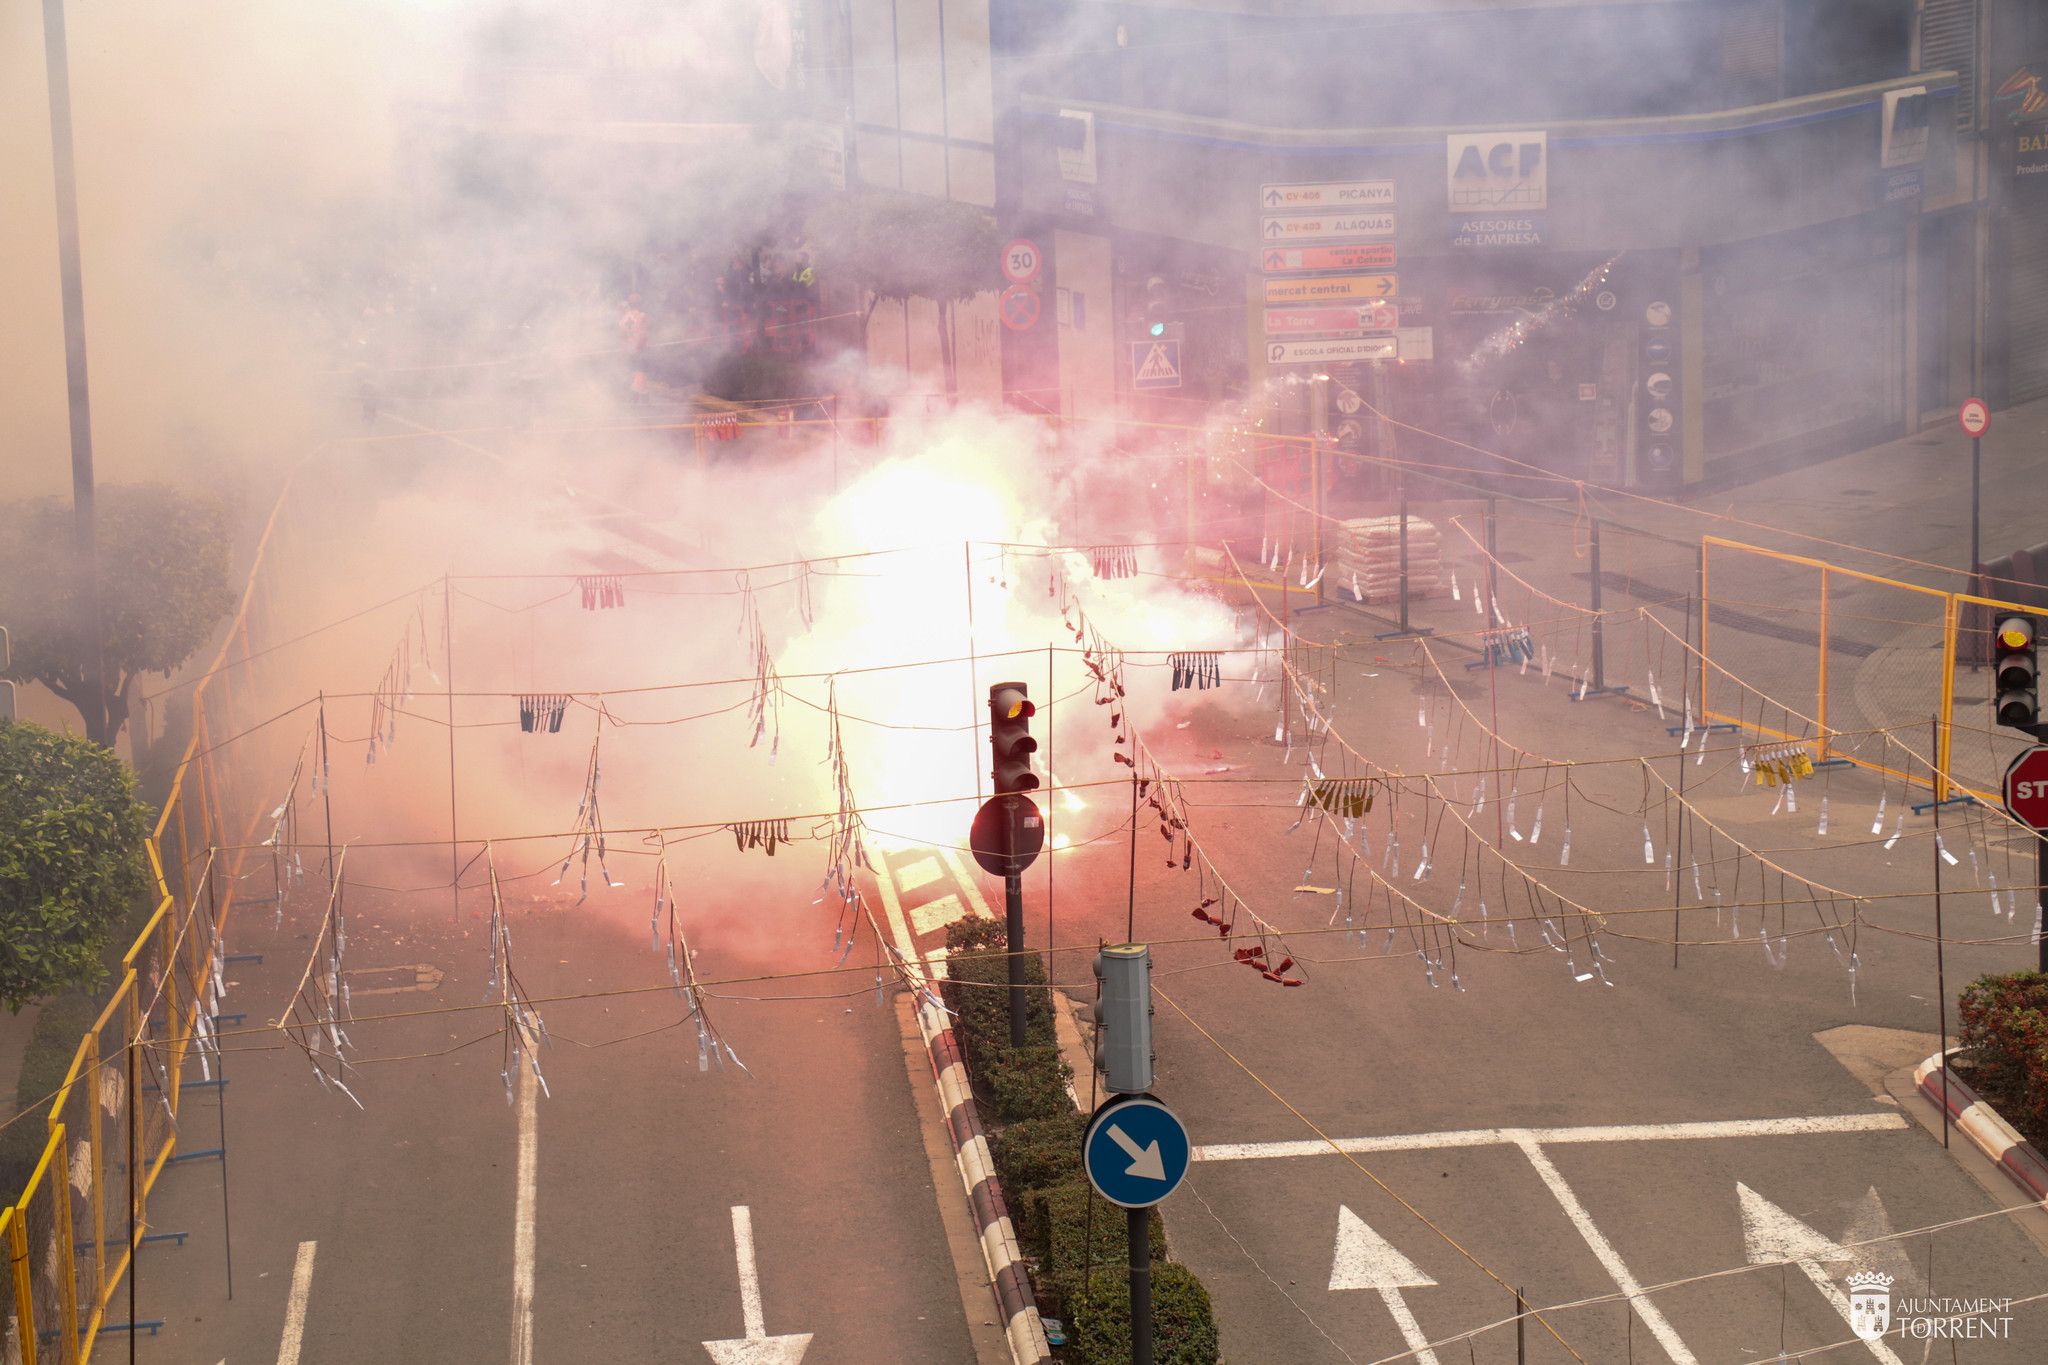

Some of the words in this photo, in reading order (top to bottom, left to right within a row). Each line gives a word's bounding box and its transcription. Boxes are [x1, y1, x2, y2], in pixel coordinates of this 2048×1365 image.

[1339, 188, 1391, 199] PICANYA
[1461, 220, 1532, 232] ASESORES
[1454, 236, 1471, 245] de
[1476, 232, 1541, 245] EMPRESA
[1011, 252, 1033, 270] 30
[1268, 284, 1306, 296] mercat
[1310, 284, 1352, 295] central
